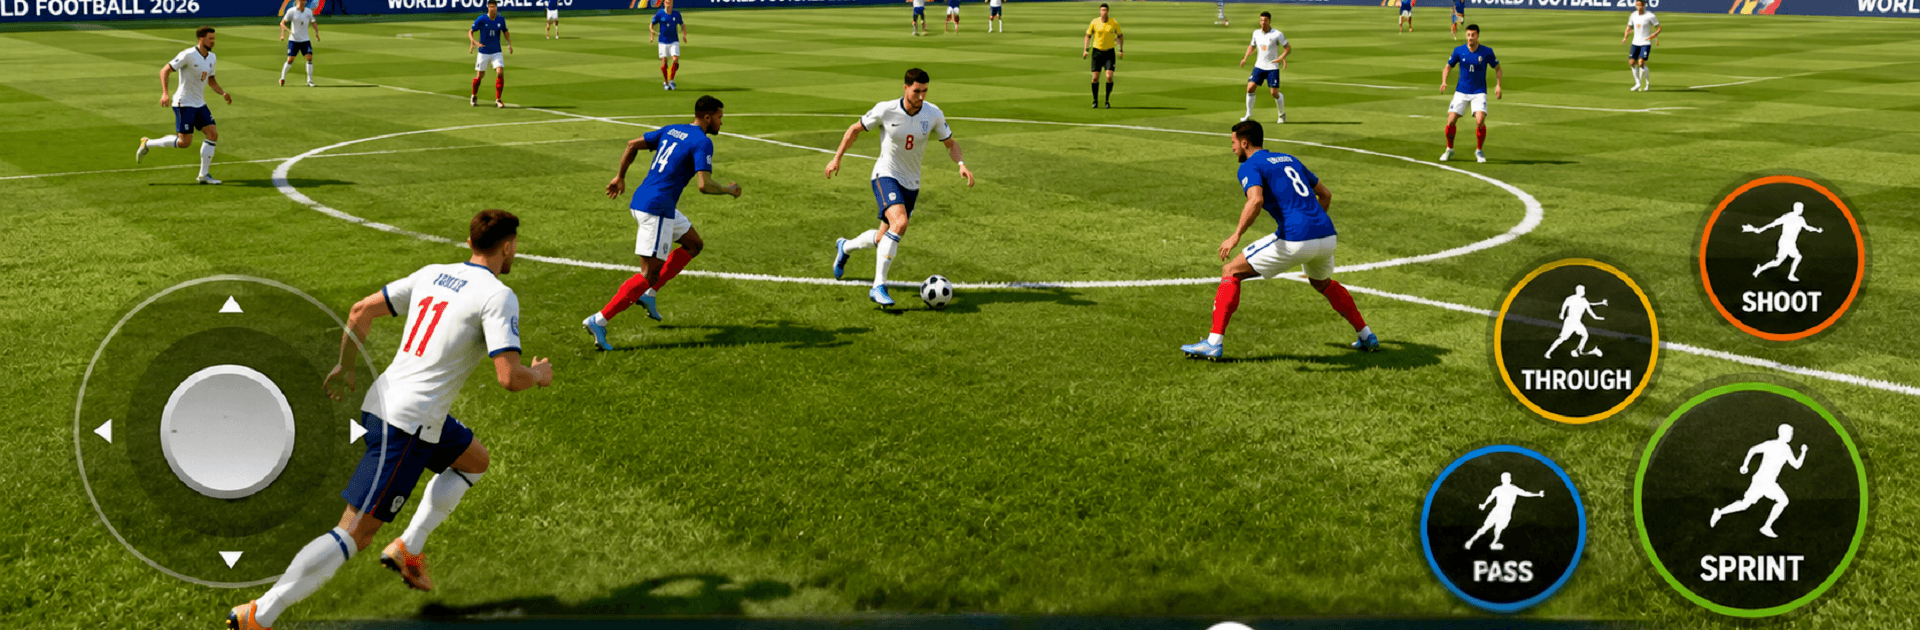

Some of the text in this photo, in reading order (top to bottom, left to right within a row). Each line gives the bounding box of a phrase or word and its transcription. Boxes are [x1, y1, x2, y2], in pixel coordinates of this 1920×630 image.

[36, 0, 145, 16] FOOTBALL
[150, 0, 200, 14] 2026
[650, 139, 678, 174] 14
[905, 134, 915, 150] 8
[1284, 166, 1310, 197] 8
[403, 295, 449, 358] 11
